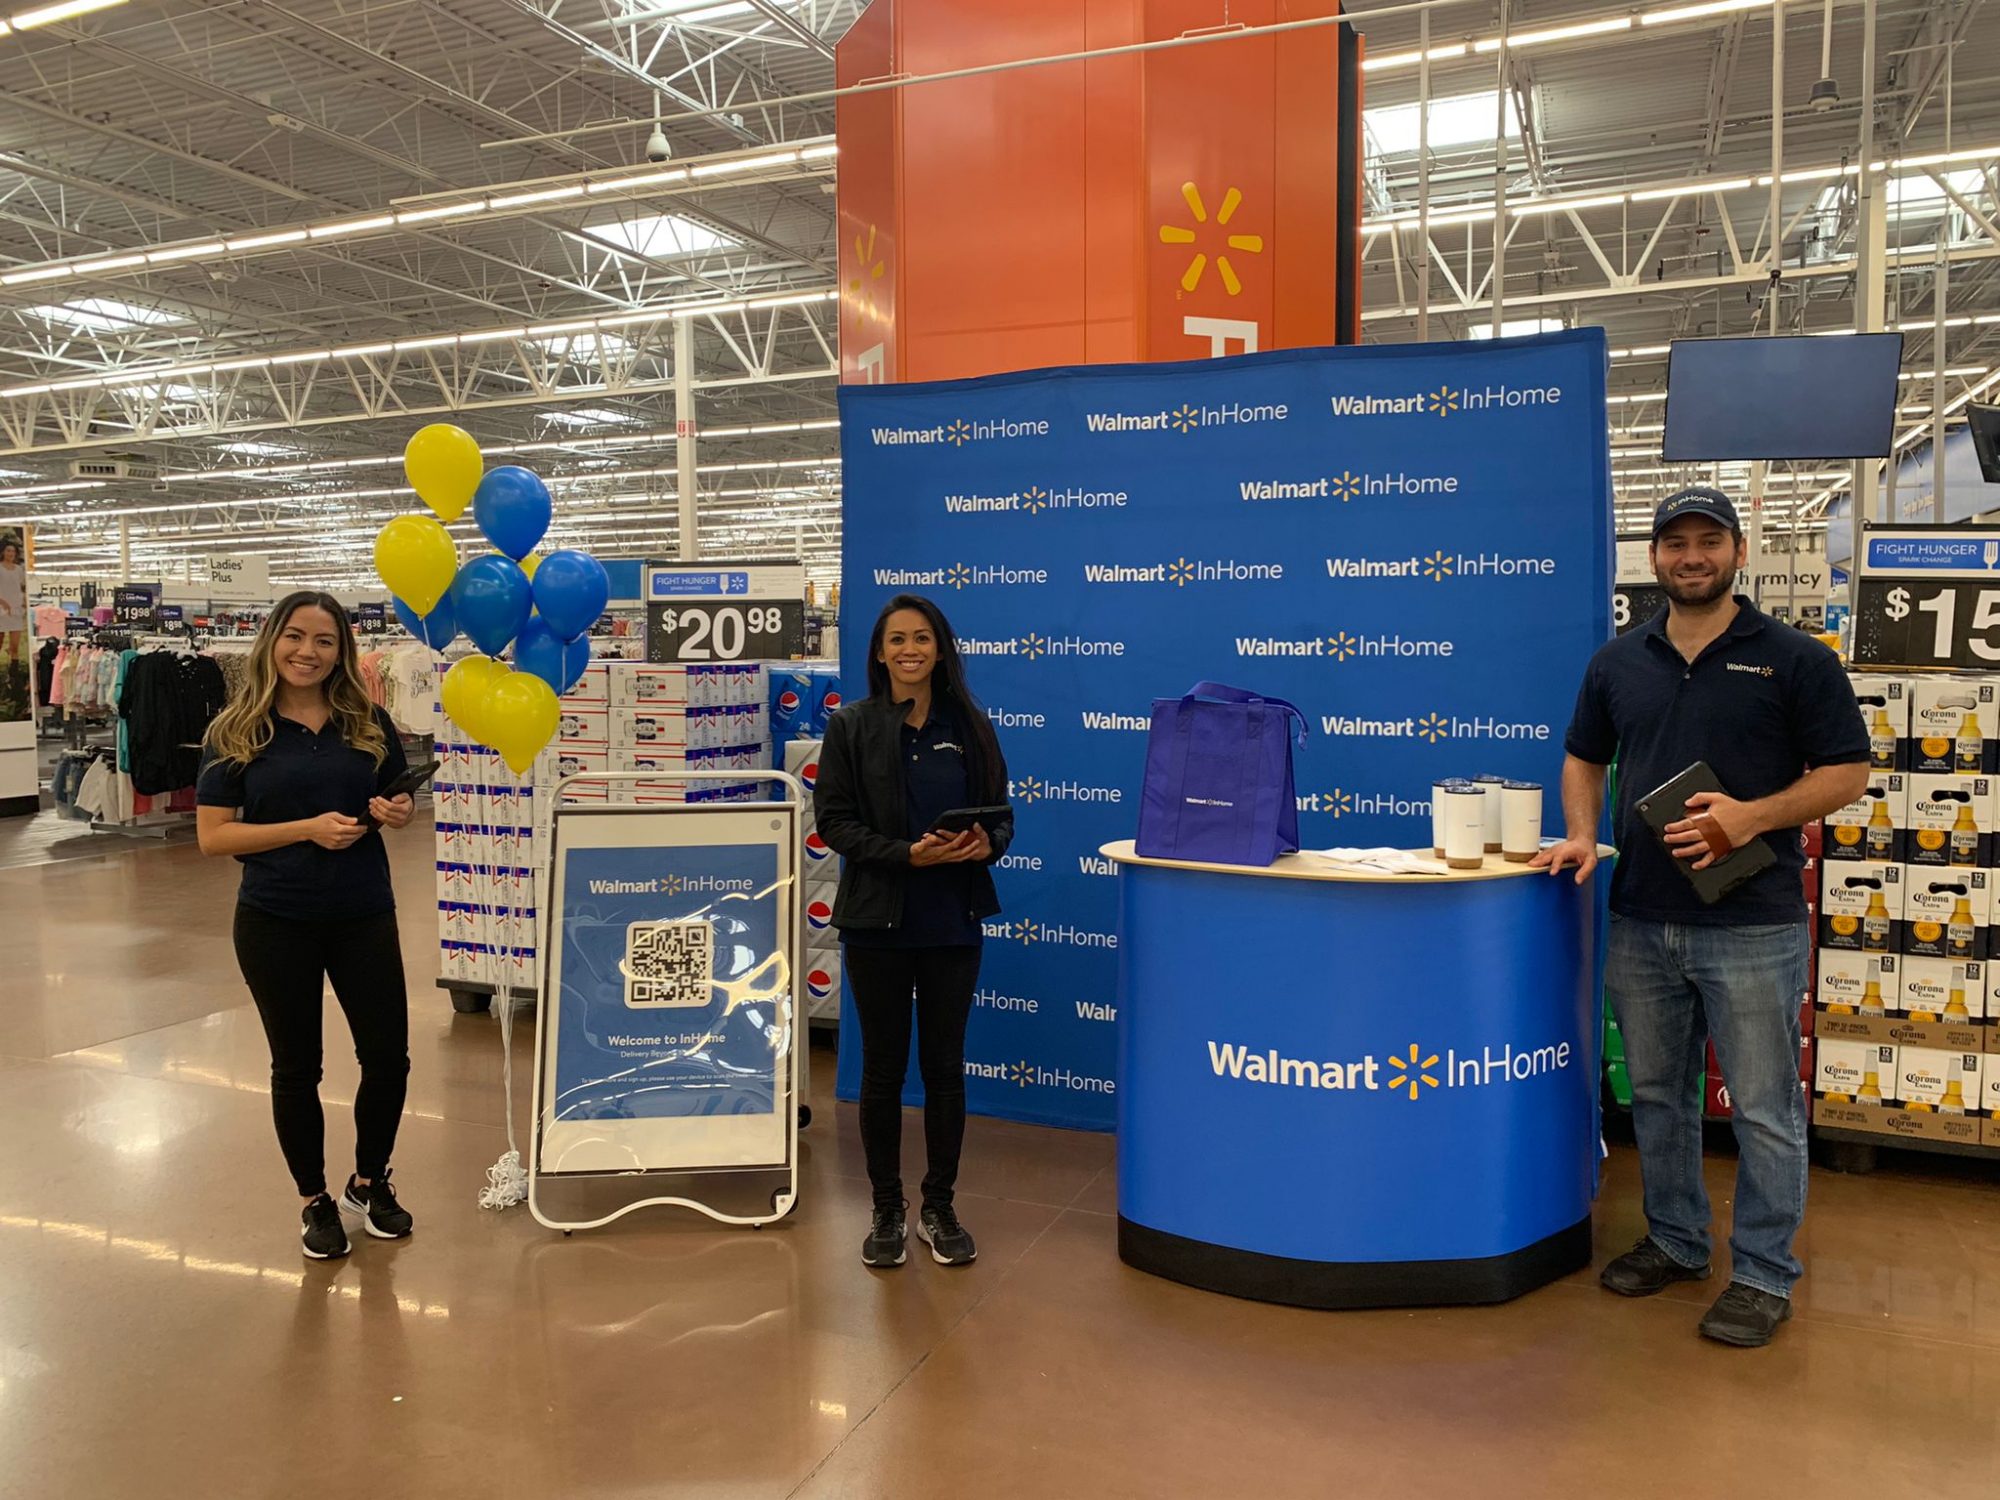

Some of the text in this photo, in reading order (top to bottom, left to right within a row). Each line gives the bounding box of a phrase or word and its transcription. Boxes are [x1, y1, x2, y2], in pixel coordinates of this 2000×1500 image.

[1332, 386, 1561, 415] Walmart InHome
[1086, 404, 1287, 432] Walmart InHome
[872, 419, 1049, 445] Walmart InHome
[1240, 473, 1458, 501] Walmart InHome
[945, 488, 1128, 512] Walmart InHome
[1876, 544, 1977, 555] FIGHT HUNGER
[210, 558, 243, 570] Ladies'
[1327, 554, 1555, 578] Walmart InHome
[211, 571, 232, 582] Plus
[874, 565, 1048, 586] Walmart InHome
[1085, 560, 1282, 582] Walmart InHome
[656, 576, 717, 585] FIGHT HUNGER
[1047, 636, 1125, 656] InHome
[1236, 635, 1454, 657] Walmart InHome
[1726, 662, 1761, 674] Walmart
[1891, 684, 1899, 692] 12
[1982, 687, 1991, 695] 12
[987, 707, 1045, 728] Home
[1920, 708, 1957, 720] Corona
[1322, 716, 1550, 740] Walmart InHome
[1977, 780, 1986, 788] 12
[1044, 780, 1122, 803] InHome
[1354, 792, 1432, 817] InHom
[1916, 801, 1952, 812] Corona
[995, 854, 1043, 871] ome
[1888, 868, 1896, 876] 12
[1974, 873, 1983, 881] 12
[589, 875, 753, 895] Walmart InHome
[1830, 887, 1864, 898] Corona
[1913, 893, 1949, 903] Corona
[1041, 923, 1118, 949] InHome
[1826, 975, 1860, 986] Corona
[1908, 982, 1945, 993] Corona
[972, 988, 1039, 1014] nHome
[608, 1035, 661, 1046] Welcome
[664, 1034, 677, 1044] to
[1889, 1029, 1926, 1040] Corona
[620, 1050, 648, 1058] Delivery
[1882, 1048, 1890, 1056] 12
[1208, 1041, 1570, 1090] Walmart InHome
[1966, 1056, 1974, 1064] 12
[1824, 1065, 1859, 1076] Corona
[1037, 1065, 1116, 1094] InHome
[1905, 1073, 1941, 1084] Corona
[1887, 1118, 1923, 1129] Corona
